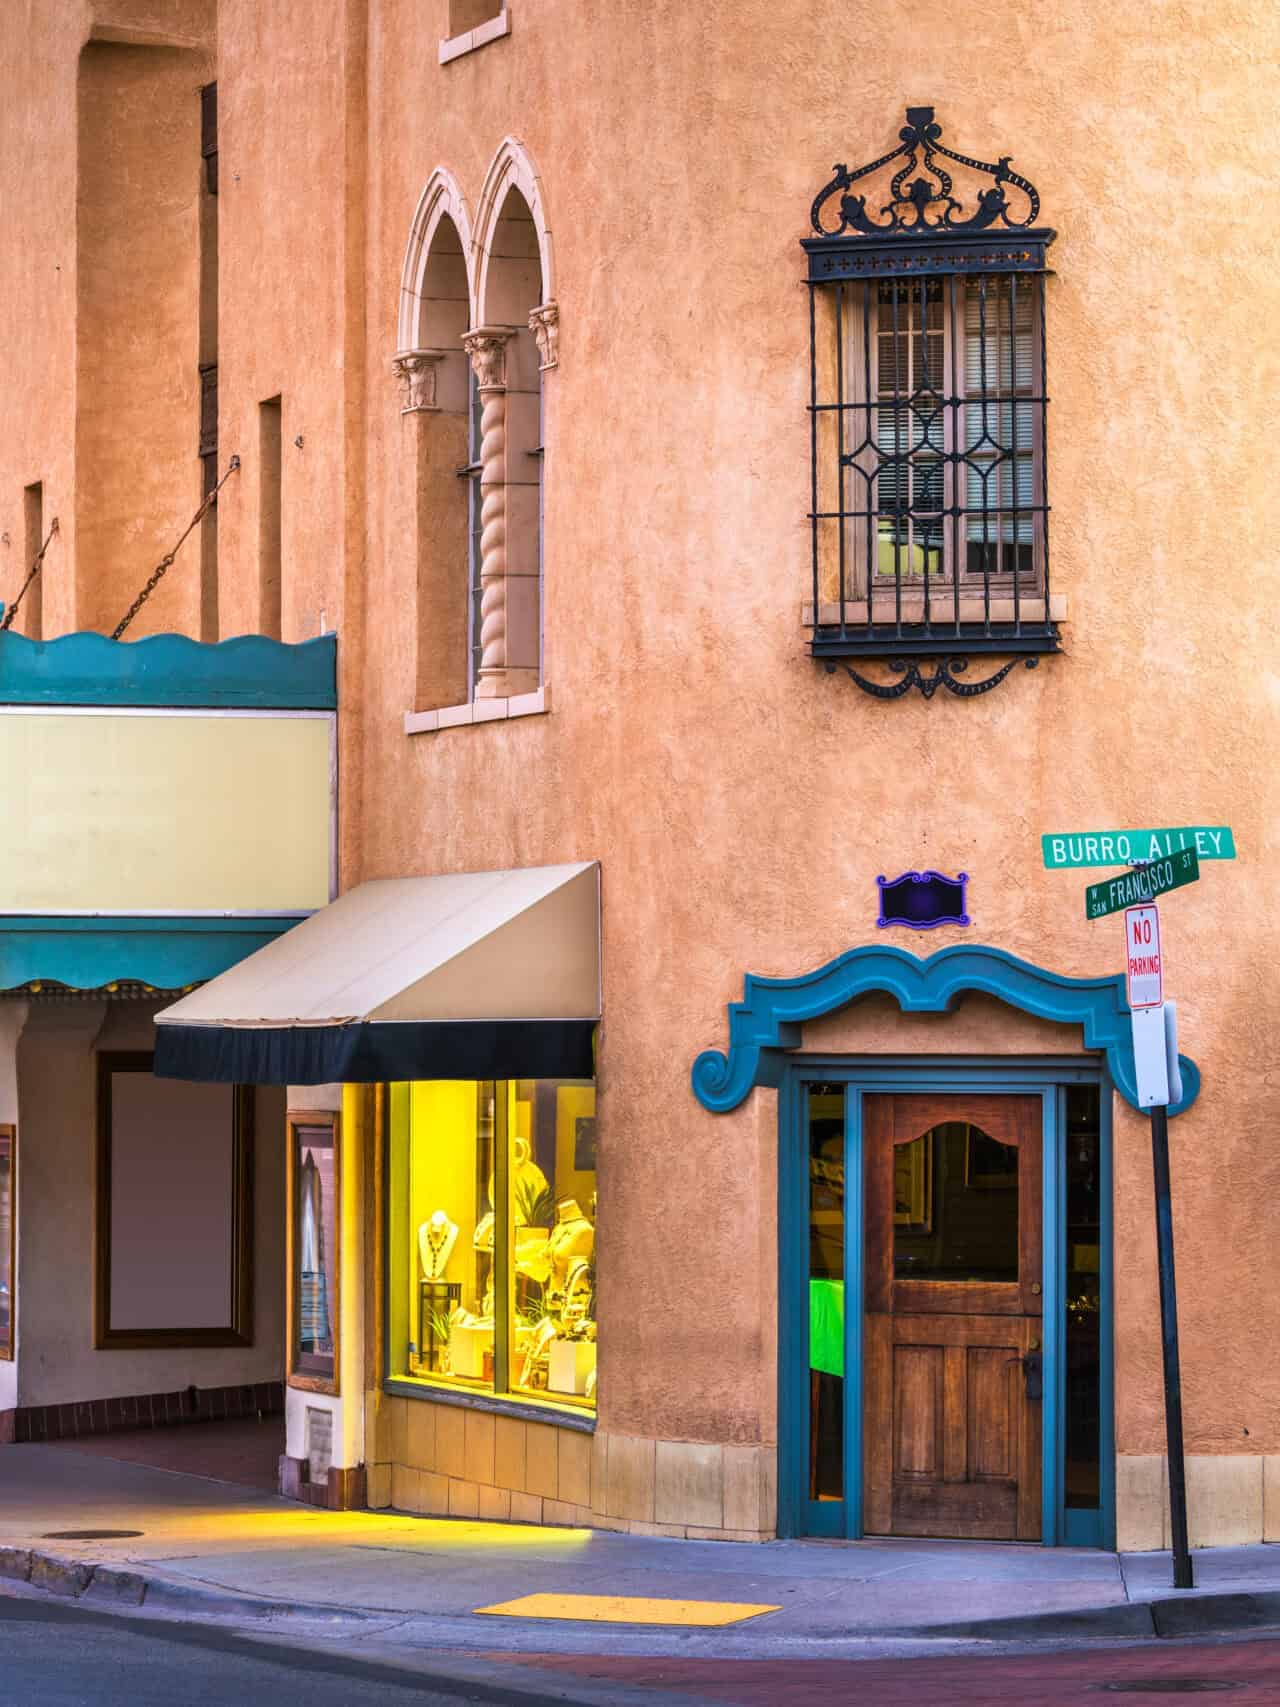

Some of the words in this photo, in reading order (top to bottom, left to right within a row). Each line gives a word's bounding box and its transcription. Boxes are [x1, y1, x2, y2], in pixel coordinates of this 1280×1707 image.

[1052, 835, 1131, 863] BURRO
[1182, 852, 1192, 868] ST
[1090, 887, 1098, 900] W
[1109, 860, 1174, 908] FRANCISCO
[1091, 900, 1108, 917] SAN
[1133, 919, 1152, 945] NO
[1129, 955, 1160, 977] PARKING
